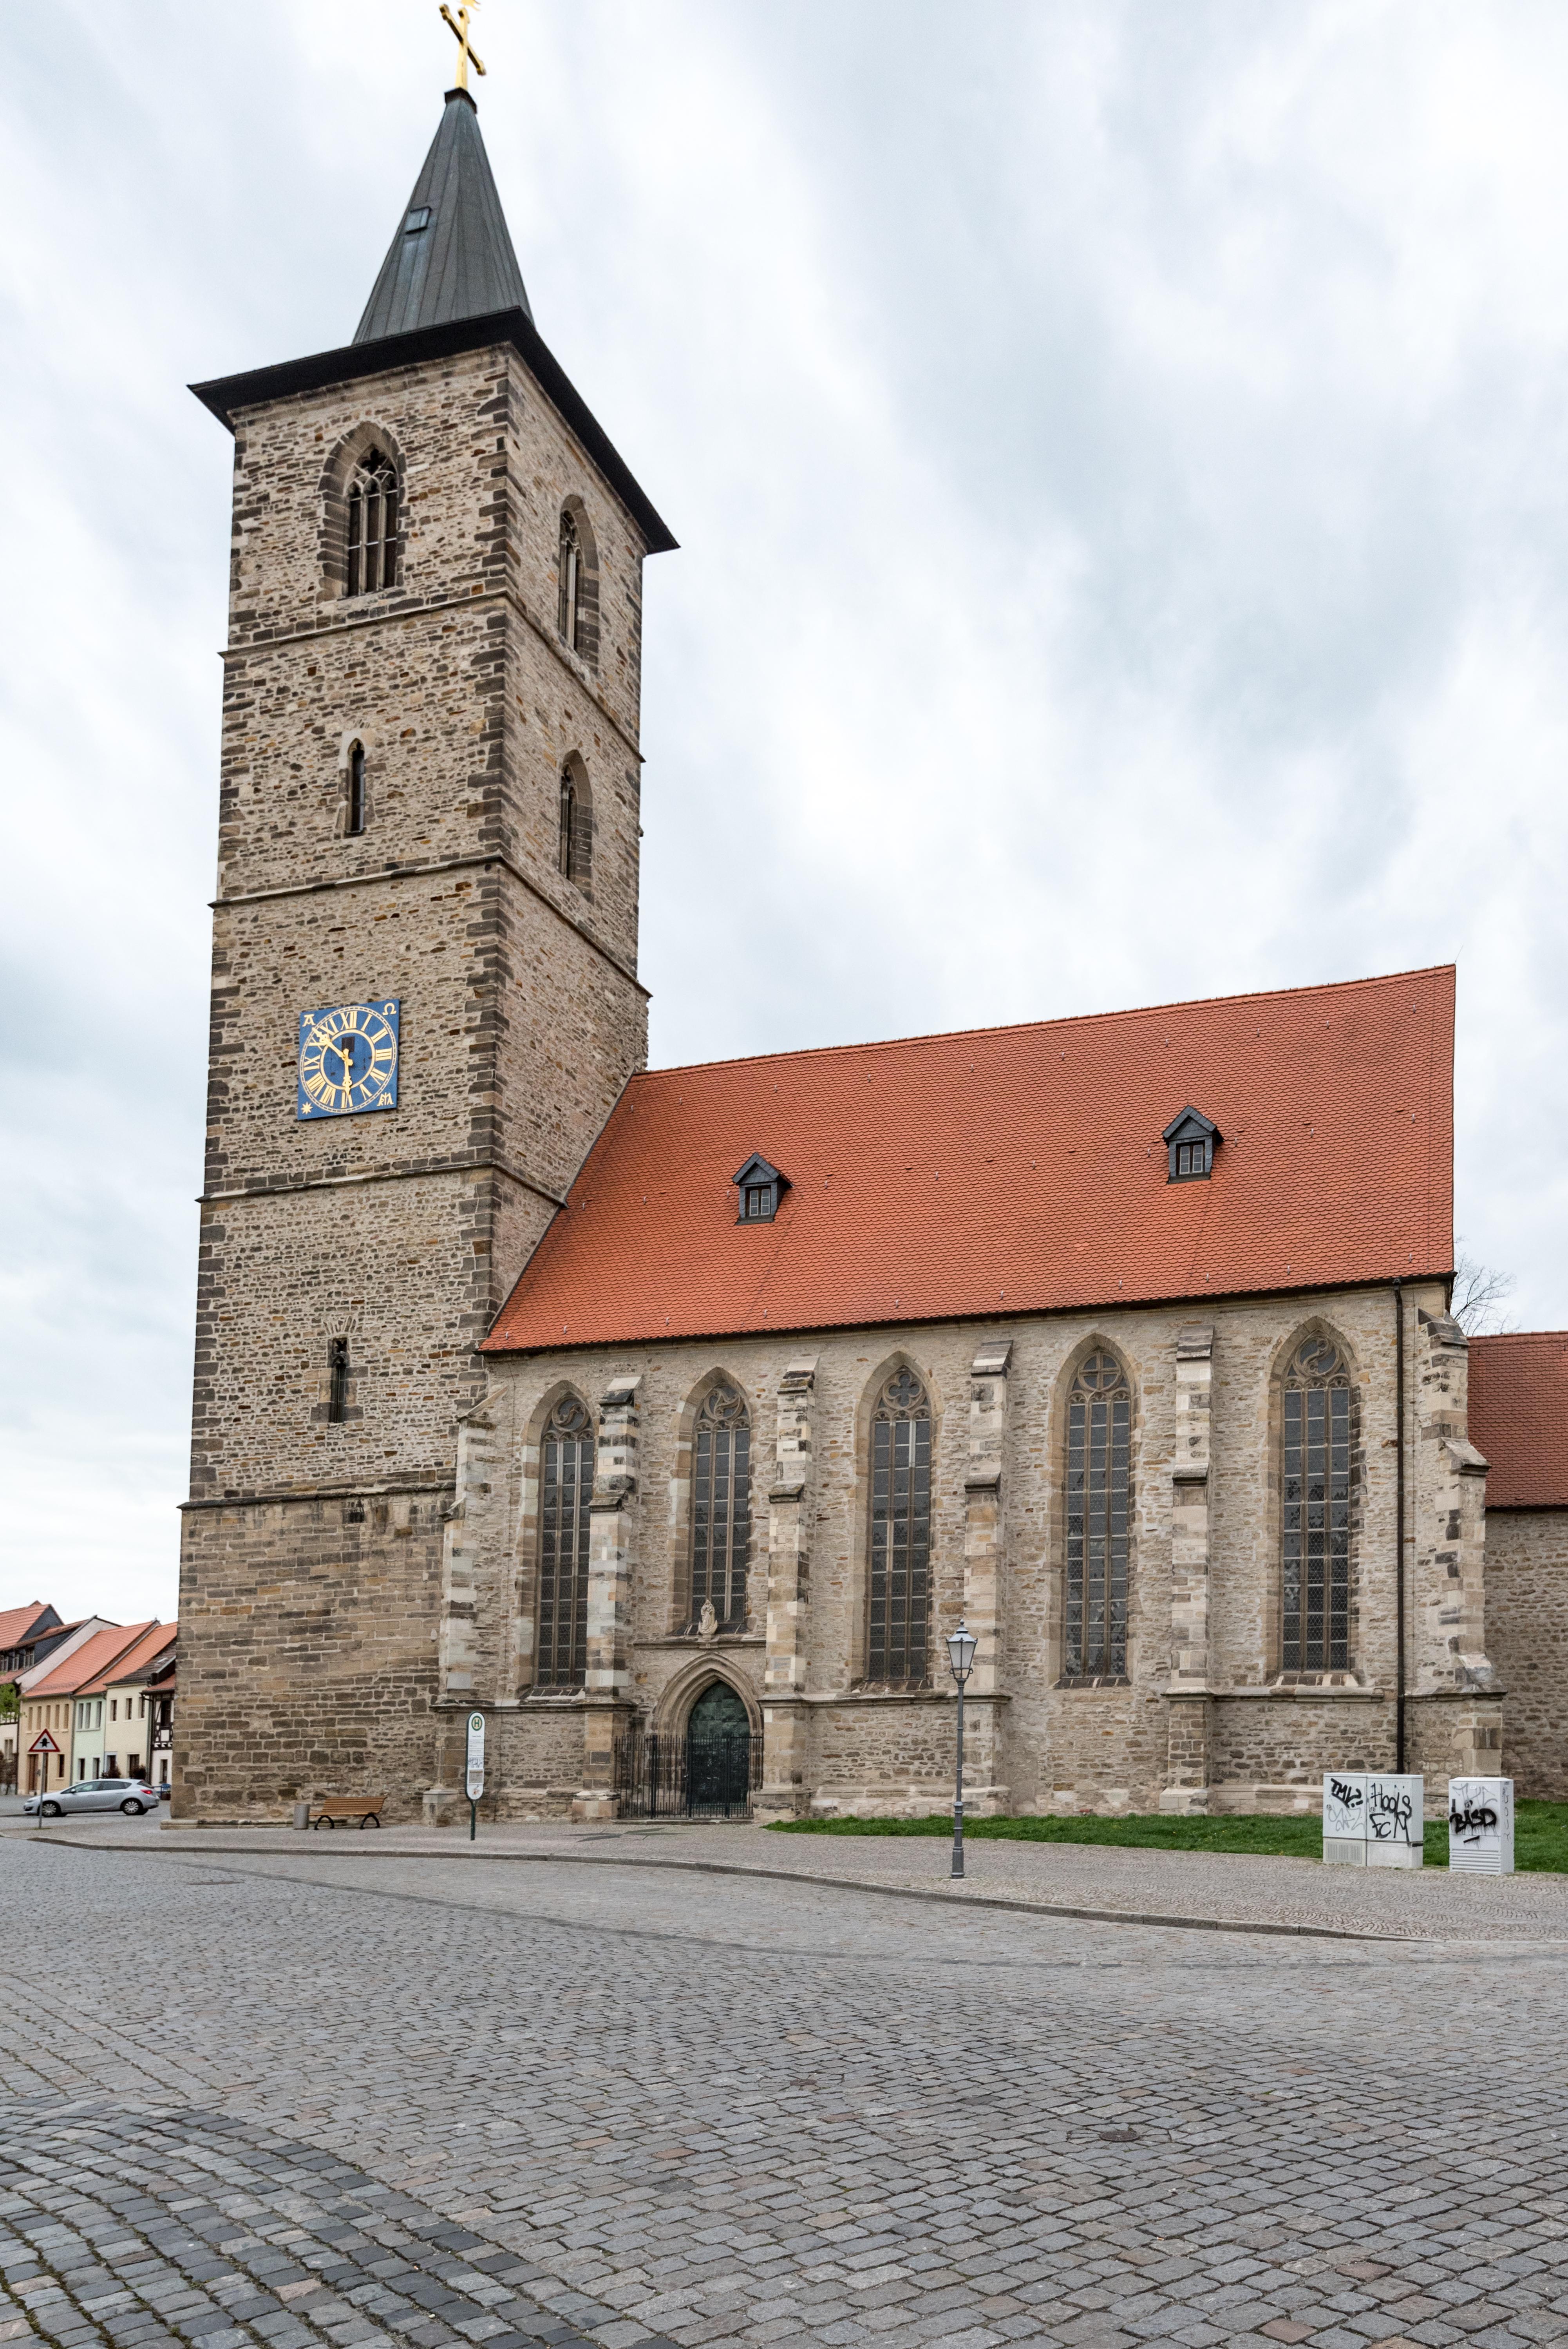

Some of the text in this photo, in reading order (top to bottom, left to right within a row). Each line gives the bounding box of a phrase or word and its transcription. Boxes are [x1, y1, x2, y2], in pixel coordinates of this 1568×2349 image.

[382, 1003, 397, 1015] Ω
[319, 1018, 339, 1040] XI
[340, 1010, 358, 1030] XII
[361, 1013, 373, 1032] I
[371, 1027, 389, 1044] II
[304, 1055, 321, 1071] IX
[375, 1048, 392, 1061] III
[306, 1072, 326, 1097] VIII
[370, 1067, 388, 1086] IV
[319, 1085, 336, 1106] VII
[341, 1091, 353, 1108] VI
[360, 1084, 373, 1101] V
